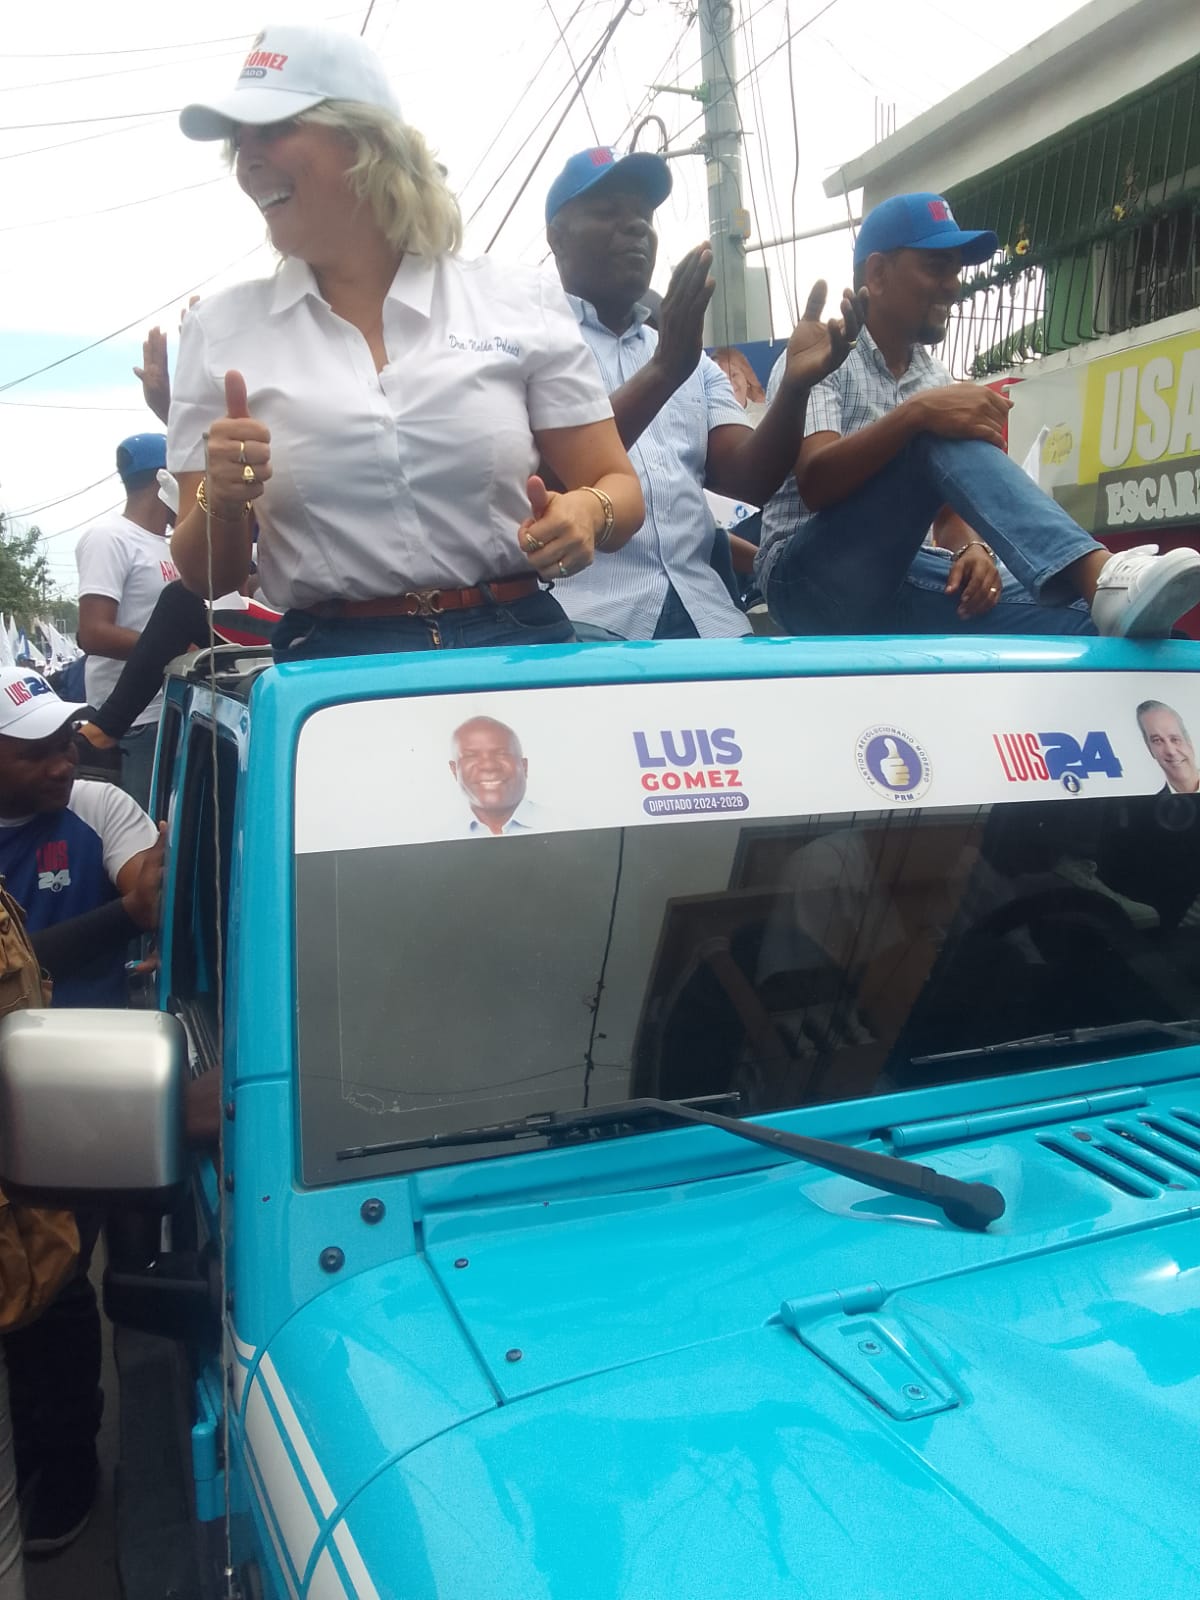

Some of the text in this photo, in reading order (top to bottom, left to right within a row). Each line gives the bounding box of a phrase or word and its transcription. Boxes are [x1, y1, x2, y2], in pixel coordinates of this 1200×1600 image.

[1106, 469, 1200, 525] ESCAR
[632, 728, 742, 768] LUIS
[857, 727, 931, 786] PARTIDO REVOLUCIONARIO MODERNO
[641, 769, 743, 791] GOMEZ
[649, 796, 744, 812] DIPUTADO 2024-2028
[894, 793, 915, 802] PRM
